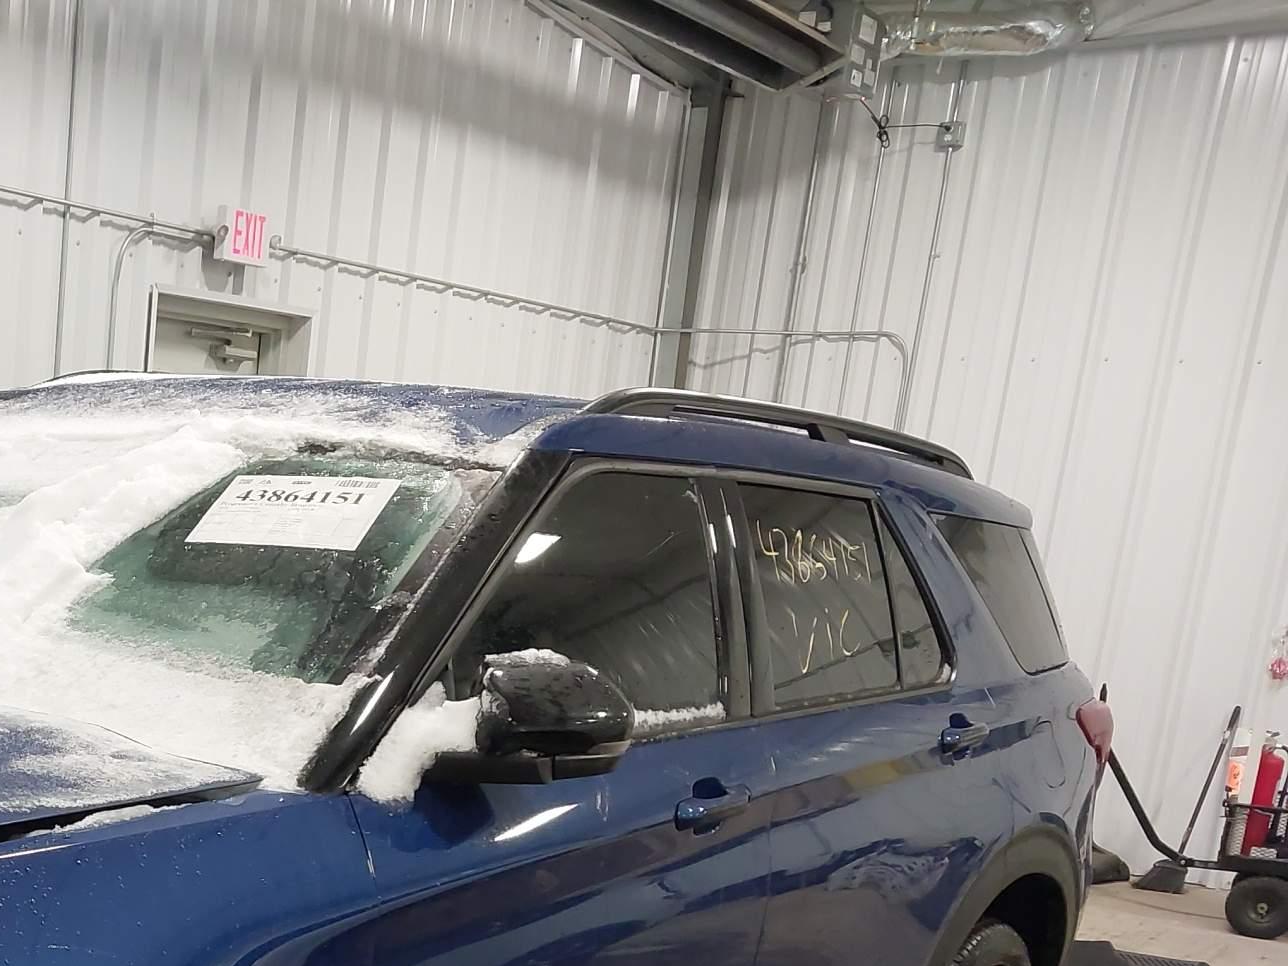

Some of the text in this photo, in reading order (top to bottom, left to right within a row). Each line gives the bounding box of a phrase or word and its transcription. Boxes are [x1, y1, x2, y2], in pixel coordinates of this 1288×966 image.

[232, 210, 266, 259] EXIT
[236, 489, 366, 505] 43864151
[756, 519, 872, 585] 43864151
